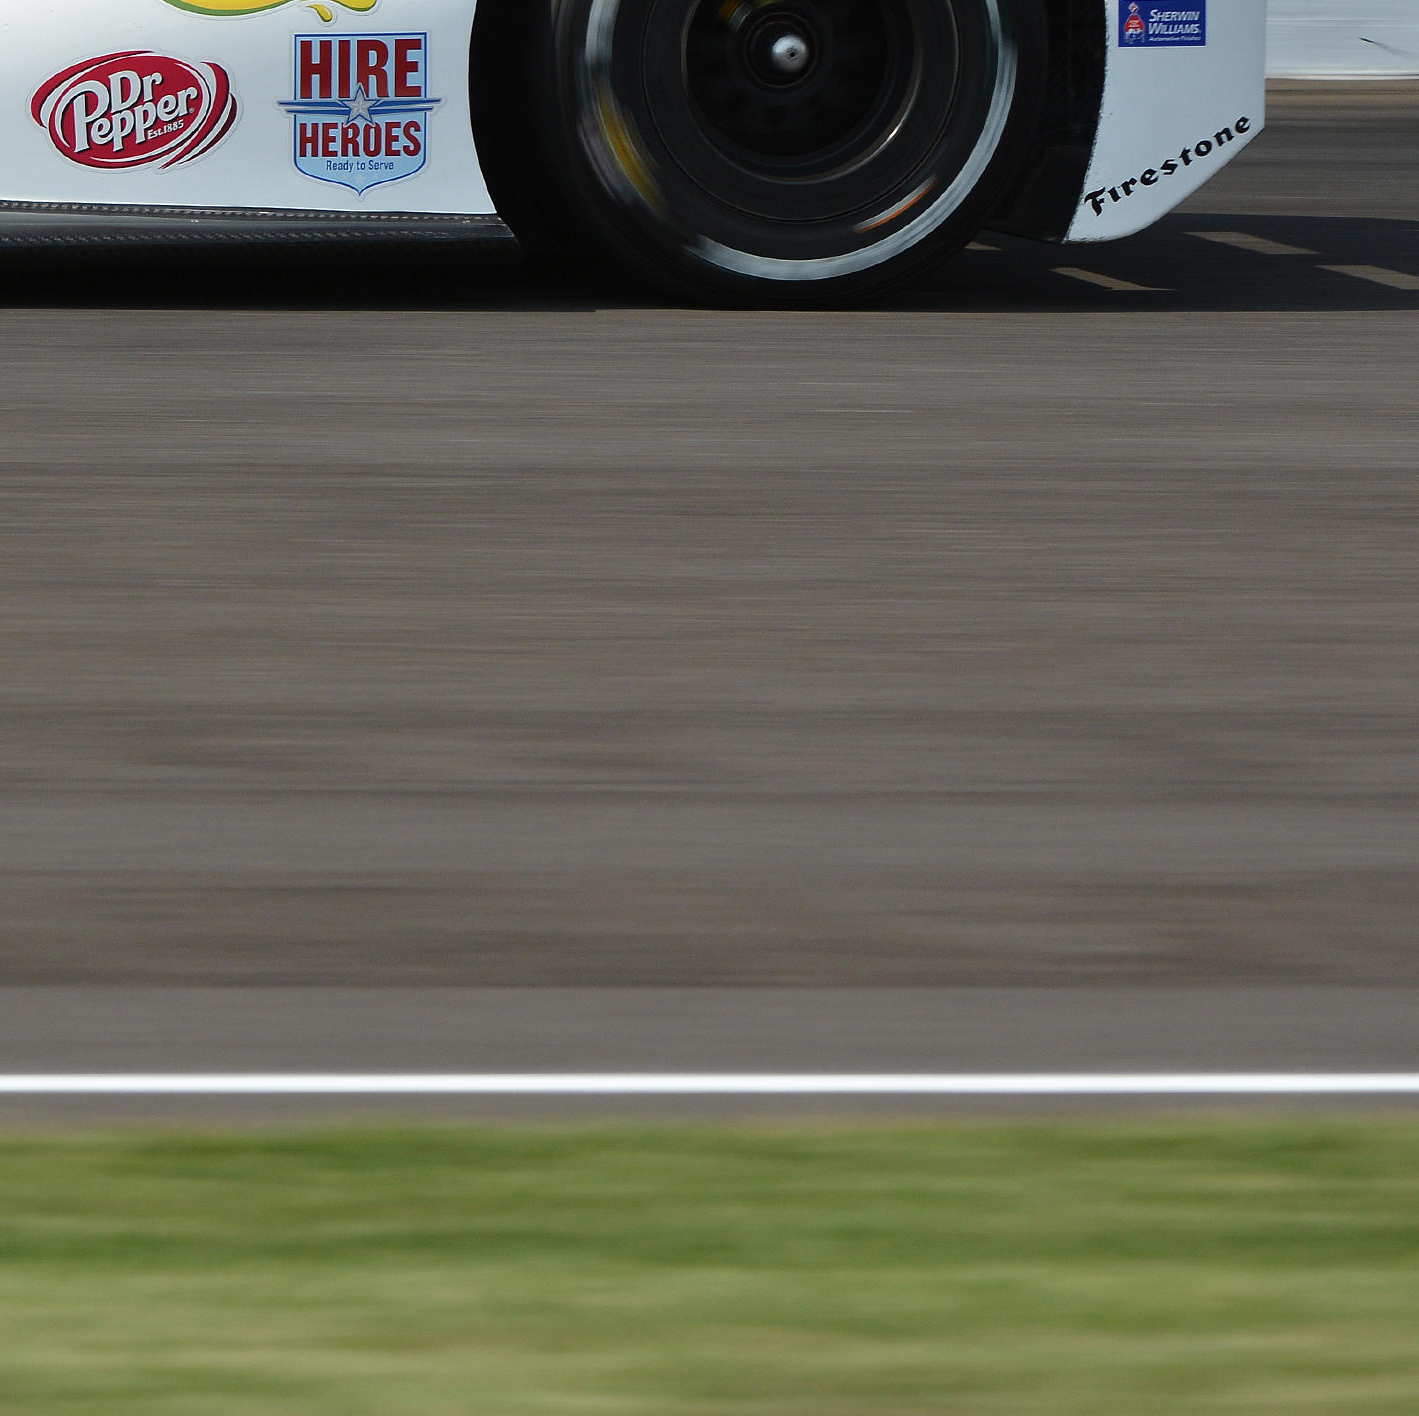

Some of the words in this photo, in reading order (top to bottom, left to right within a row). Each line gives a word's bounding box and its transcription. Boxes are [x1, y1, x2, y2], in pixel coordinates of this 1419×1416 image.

[1149, 9, 1201, 22] SHERWIN
[1149, 22, 1201, 35] WILLIAMS
[300, 39, 422, 99] HIRE
[108, 70, 163, 113] Dr
[74, 80, 198, 154] Pepper
[299, 120, 422, 157] HEROES
[326, 160, 354, 172] Ready
[356, 160, 366, 171] to
[369, 160, 394, 171] Serve
[1084, 116, 1251, 216] Firestone
